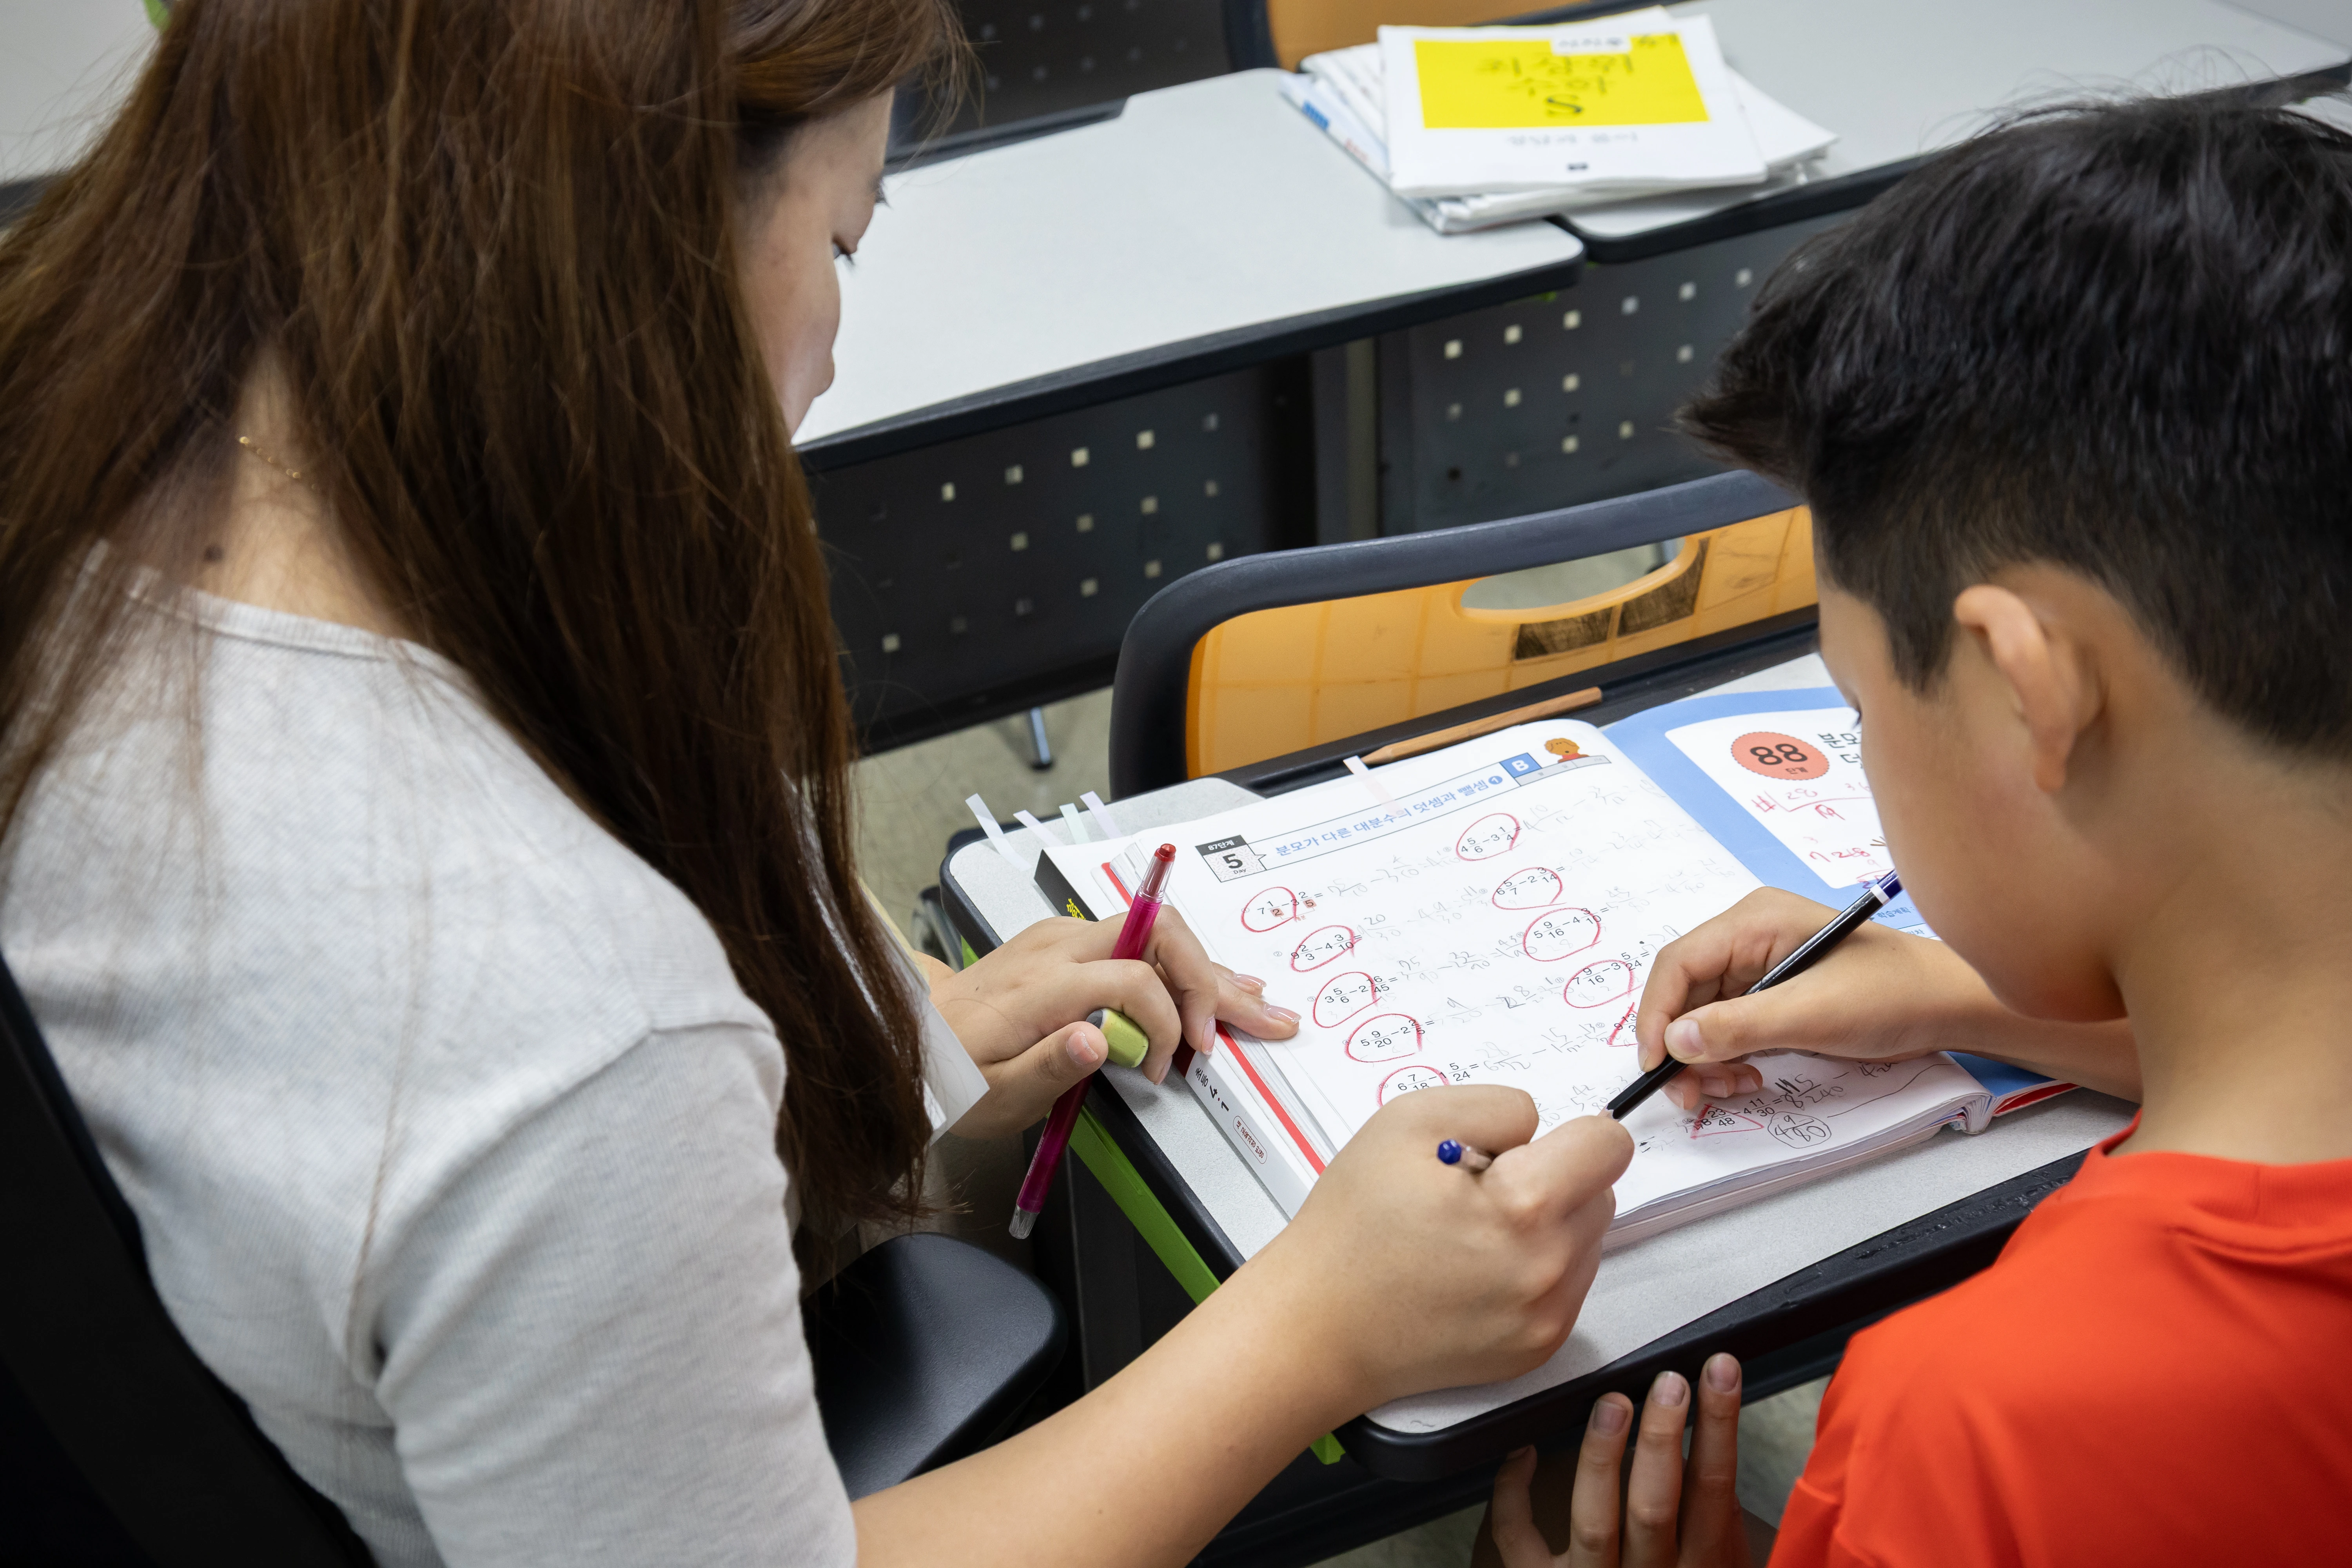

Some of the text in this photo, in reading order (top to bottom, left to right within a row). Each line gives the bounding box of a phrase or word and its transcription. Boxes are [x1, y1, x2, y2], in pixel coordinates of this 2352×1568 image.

[1545, 93, 1584, 116] S
[1818, 732, 1861, 748] 분모
[1750, 743, 1808, 765] 88
[1511, 760, 1529, 772] B
[1276, 837, 1319, 856] 분모가
[1321, 828, 1352, 840] 다른
[1353, 808, 1412, 831] 대분수의
[1413, 792, 1457, 813] 덧셈과
[1457, 779, 1489, 796] 뺄셈
[1208, 840, 1235, 851] 87단계
[1223, 854, 1243, 869] 5
[1542, 874, 1557, 882] 14
[1067, 898, 1086, 920] 상위
[1877, 907, 1911, 918] 학습계획
[1548, 929, 1564, 938] 16
[1586, 915, 1601, 924] 10
[1339, 942, 1354, 950] 10
[1588, 976, 1604, 985] 16
[1625, 960, 1642, 971] 24
[1367, 976, 1382, 984] 16
[1621, 1013, 1638, 1023] 13
[1375, 1038, 1391, 1047] 20
[1196, 1067, 1209, 1087] 초등
[1453, 1071, 1470, 1081] 24
[1749, 1098, 1766, 1107] 11
[1707, 1108, 1727, 1119] 23
[1757, 1107, 1776, 1118] 30
[1718, 1117, 1735, 1126] 48
